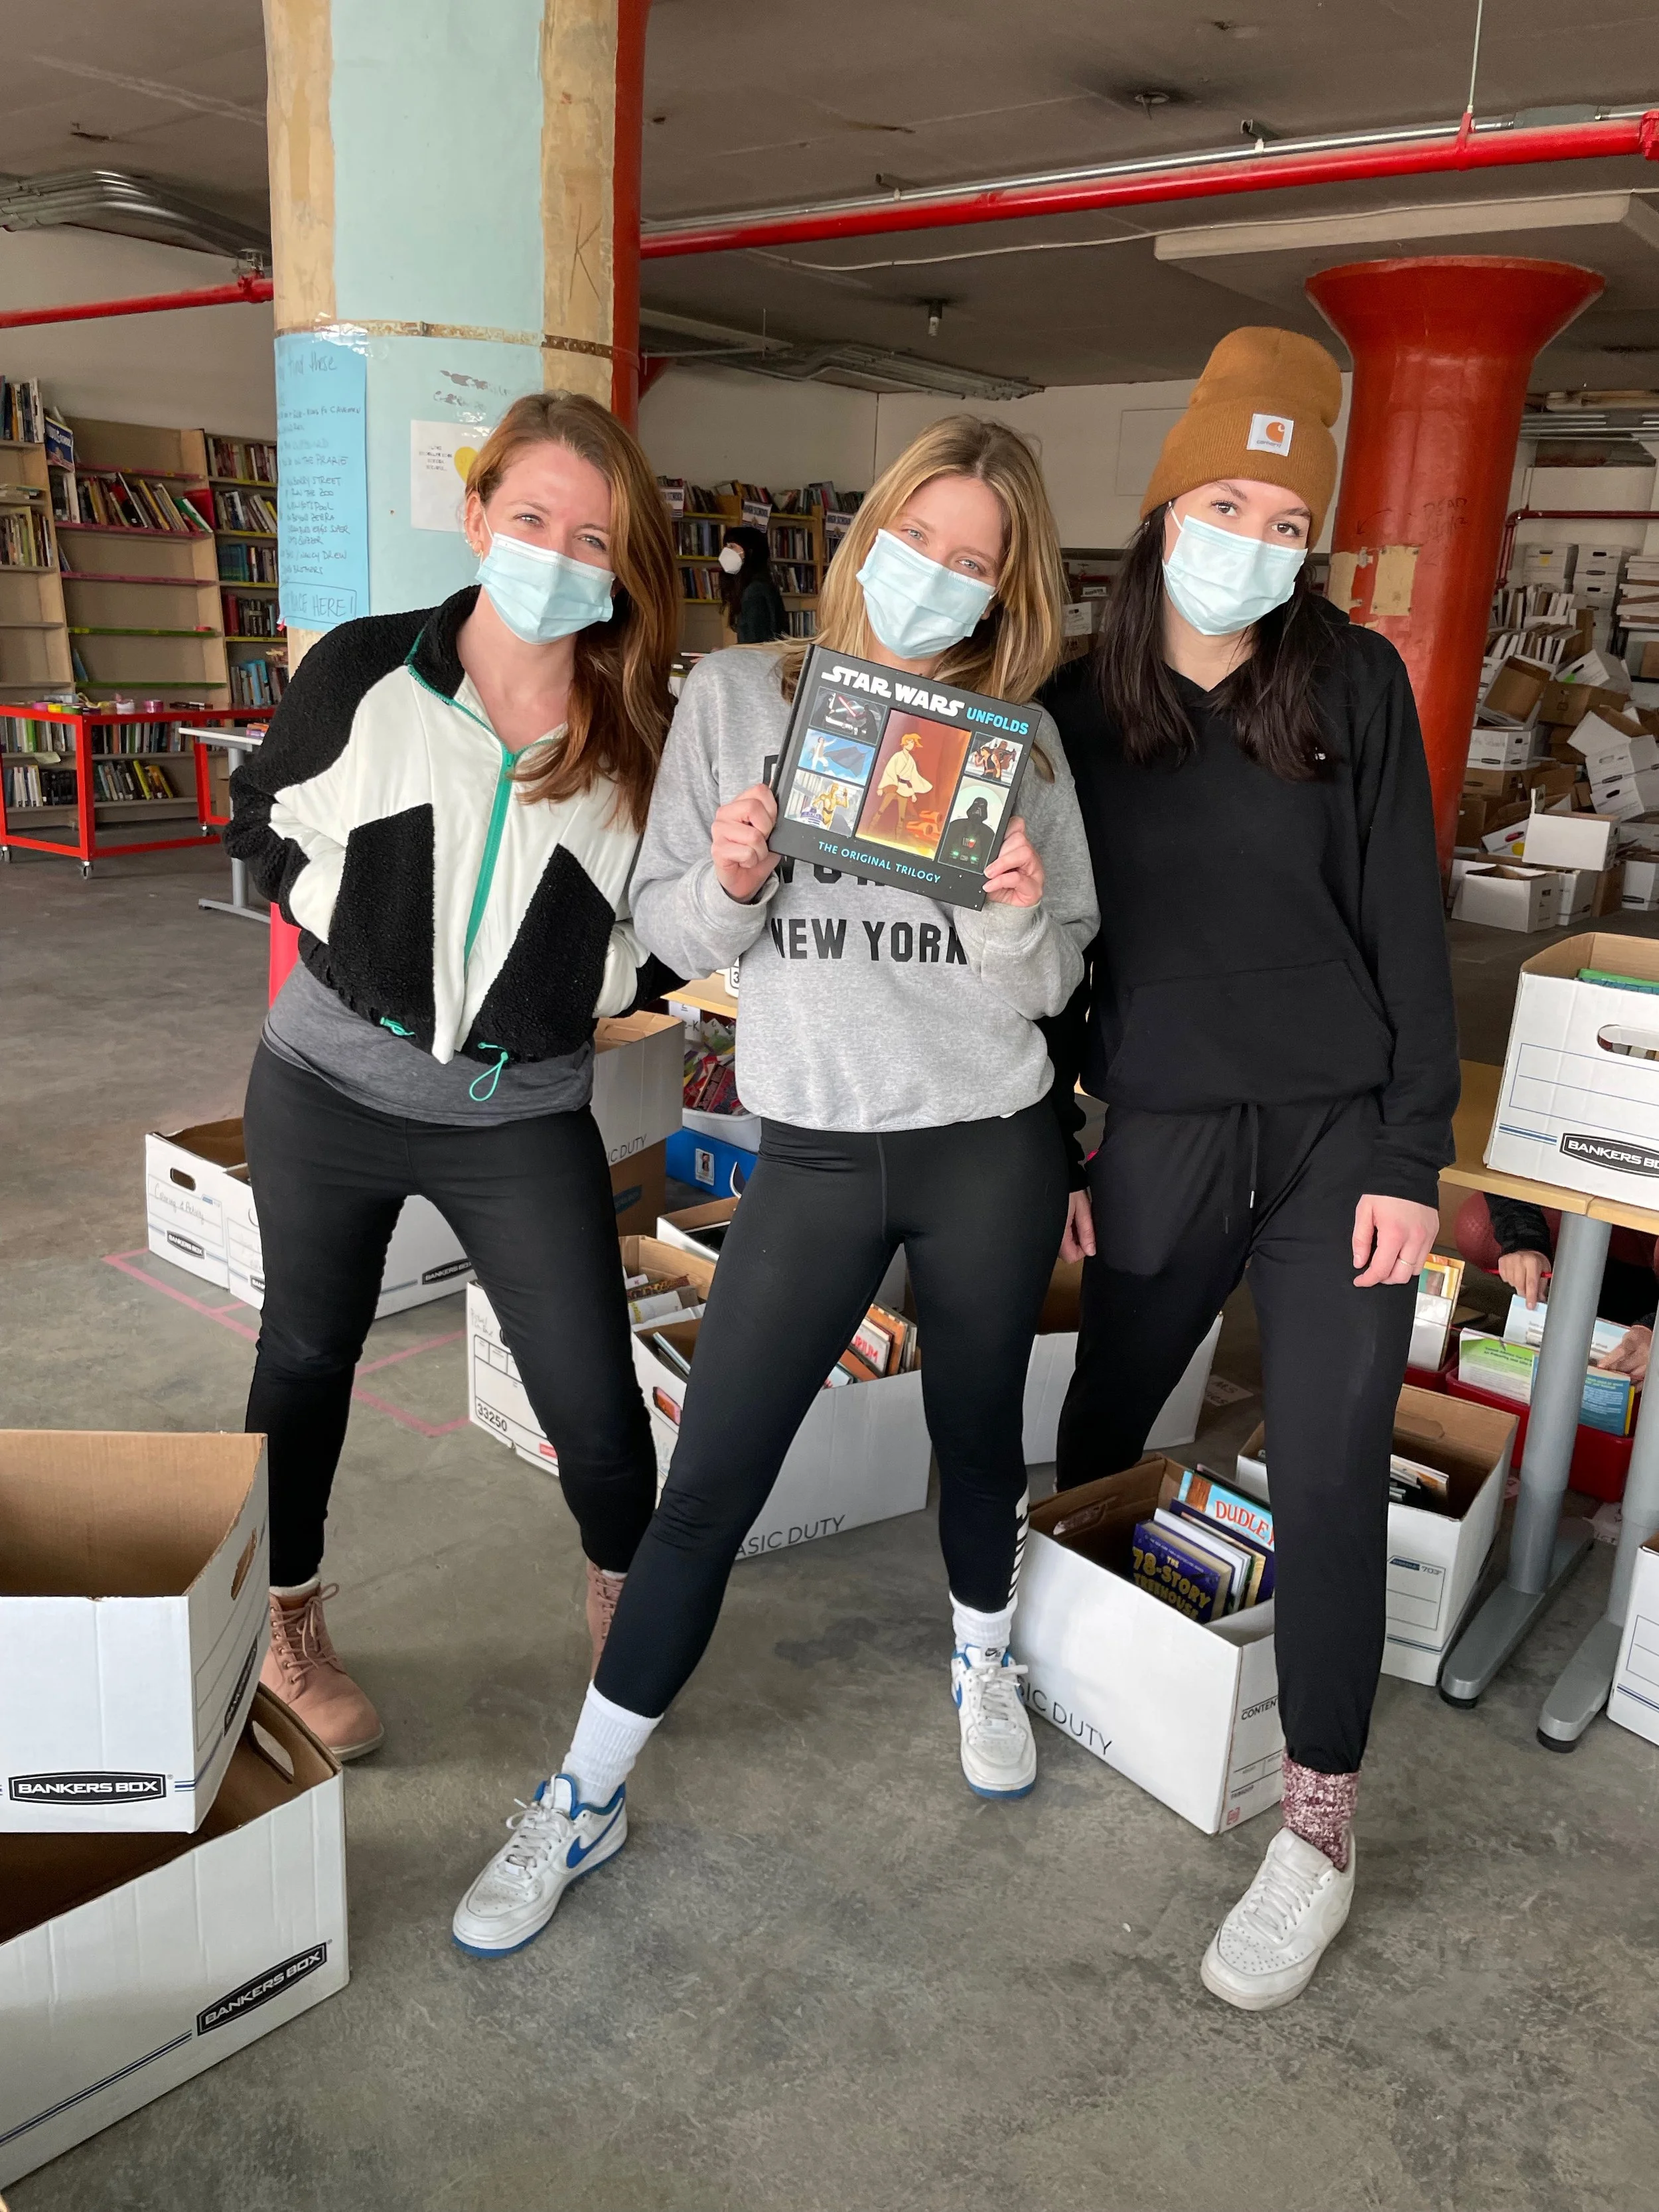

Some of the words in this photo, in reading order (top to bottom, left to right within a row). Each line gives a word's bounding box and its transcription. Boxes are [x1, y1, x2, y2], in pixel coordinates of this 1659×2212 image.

[821, 665, 892, 698] STAR
[895, 682, 966, 717] WARS
[966, 707, 1029, 735] UNFOLDS
[818, 841, 838, 854] THE
[841, 849, 891, 870] ORIGINAL
[896, 863, 941, 883] TRILOGY
[771, 917, 847, 959] NEW
[861, 920, 968, 965] YORK
[620, 1134, 647, 1158] DUTY
[1567, 1140, 1642, 1165] BANKERS
[1643, 1157, 1659, 1169] BO
[169, 1233, 192, 1251] BANKERS
[425, 1265, 459, 1281] BANKERS
[477, 1403, 508, 1432] 33250
[737, 1530, 783, 1556] ASIC
[788, 1514, 845, 1545] DUTY
[1167, 1555, 1179, 1569] THE
[1132, 1546, 1211, 1609] 78-STORY
[1242, 1698, 1277, 1720] CONTEN
[1052, 1701, 1113, 1755] DUTY
[18, 1782, 113, 1795] BANKERS
[115, 1781, 159, 1793] BOX
[205, 1972, 285, 2025] BANKERS
[286, 1951, 321, 1978] BOX
